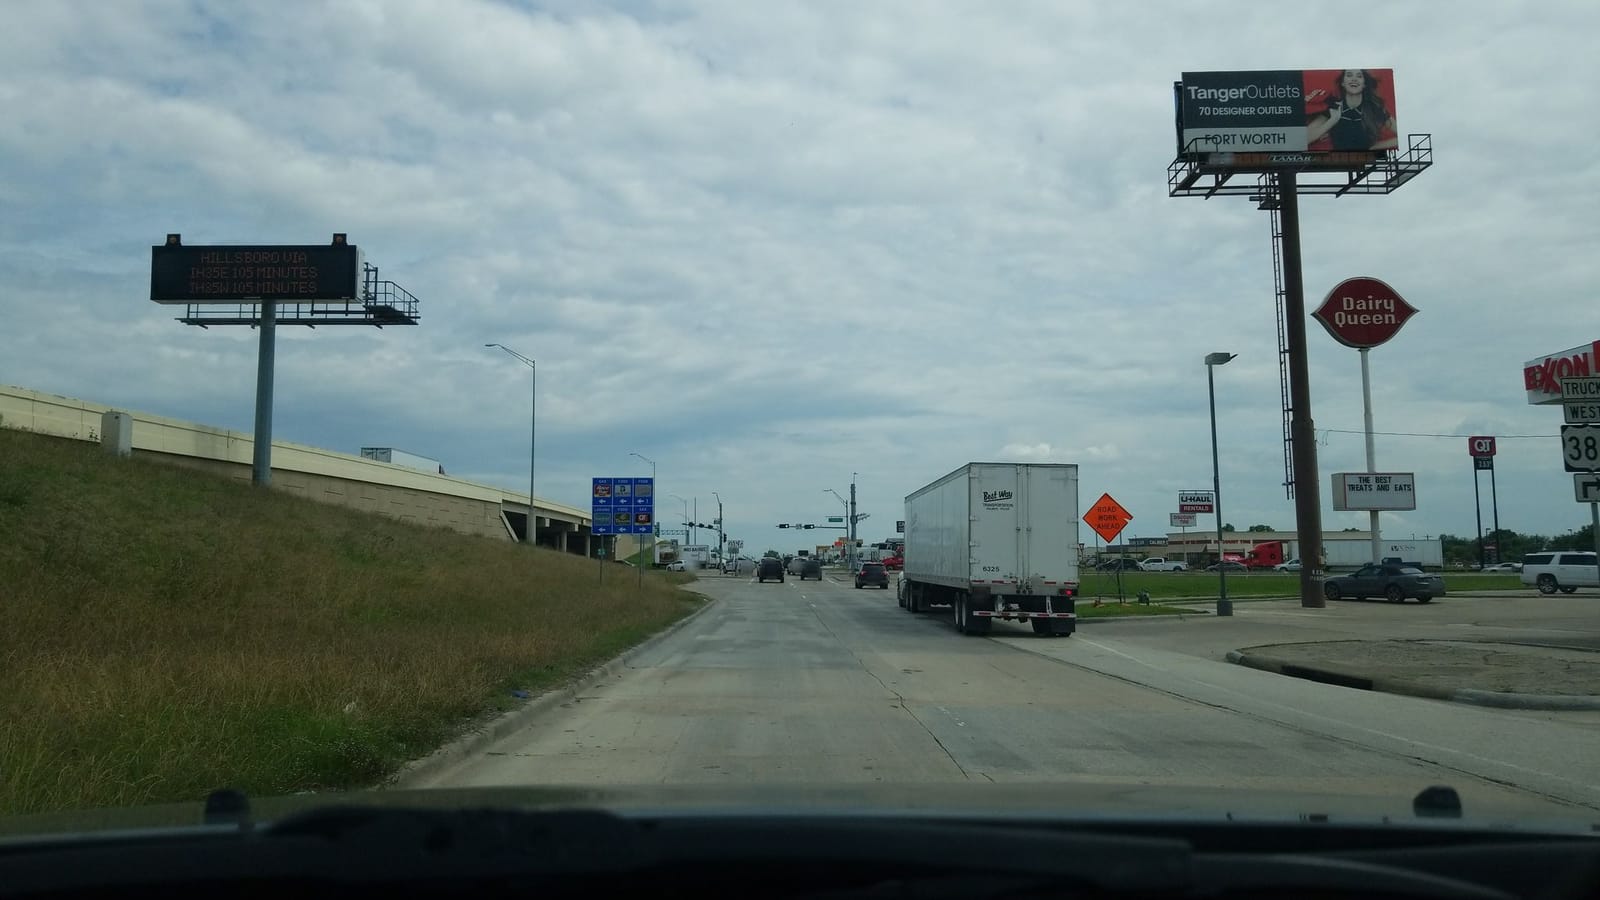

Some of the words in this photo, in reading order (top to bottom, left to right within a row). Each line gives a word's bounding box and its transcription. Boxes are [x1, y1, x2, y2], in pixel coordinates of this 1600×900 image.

[1187, 84, 1300, 102] TangerOutlets
[1199, 107, 1211, 116] 70
[1212, 107, 1256, 115] DESIGNER
[1257, 106, 1292, 115] OUTLETS
[1205, 134, 1237, 145] FORT
[1239, 133, 1286, 145] WORTH
[1272, 155, 1312, 163] LAMAR
[201, 252, 280, 264] HILLSBORO
[283, 252, 307, 264] VIA
[191, 267, 230, 279] IH35E
[233, 267, 254, 279] 105
[256, 267, 318, 279] MINUTES
[190, 282, 229, 294] IH35W
[233, 282, 254, 294] 105
[256, 282, 318, 294] MINUTES
[1342, 295, 1395, 313] Dairy
[1334, 311, 1396, 328] Queen
[1524, 352, 1590, 394] EXXON
[1563, 382, 1600, 395] TRUCK
[1474, 439, 1492, 452] QT
[1358, 476, 1371, 484] THE
[1375, 476, 1392, 484] BEST
[983, 491, 997, 501] Best
[998, 490, 1013, 499] Way
